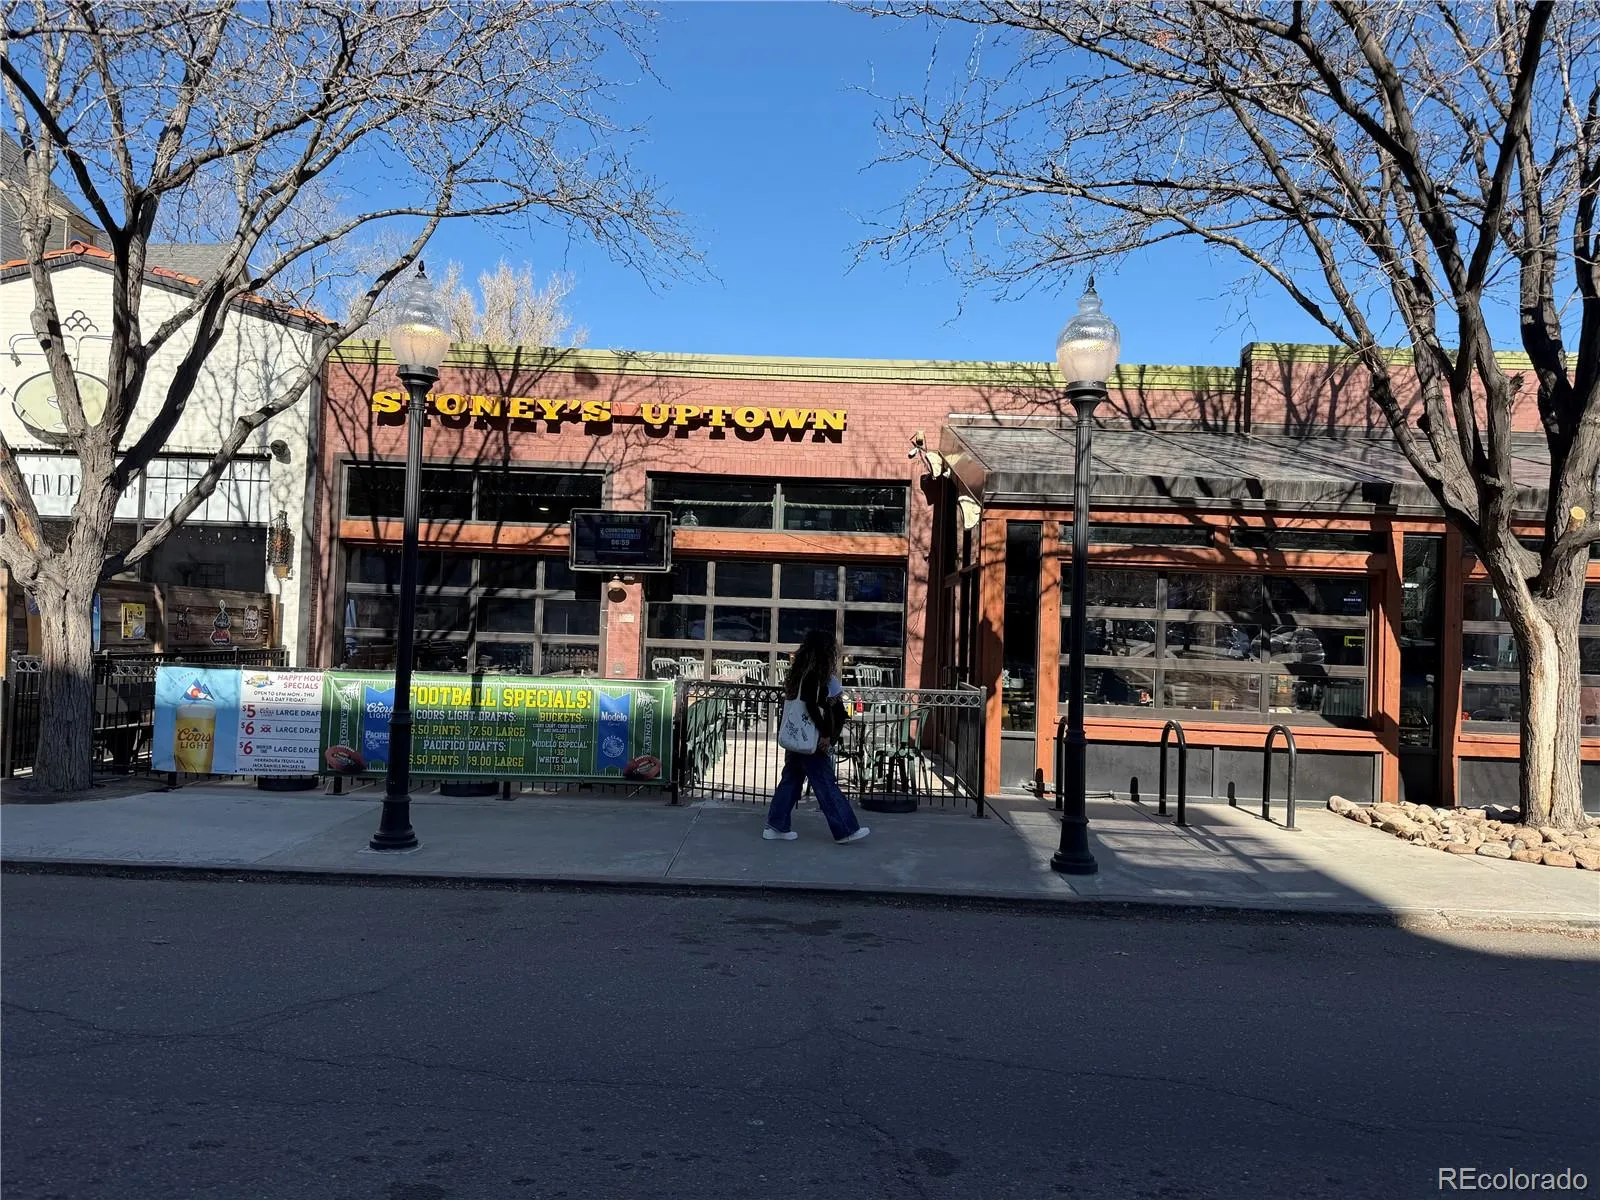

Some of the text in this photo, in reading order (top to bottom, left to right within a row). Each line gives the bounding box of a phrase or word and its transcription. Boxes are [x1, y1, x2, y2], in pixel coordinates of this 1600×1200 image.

[372, 391, 848, 430] SONEY'S UPTOWN
[283, 682, 319, 690] SPECIALS
[503, 688, 592, 709] SPECIALS!
[242, 704, 256, 718] $5
[367, 702, 394, 713] Coors
[416, 709, 517, 722] COORS LIGHT DRAFTS:
[540, 711, 585, 723] BUCKETS:
[241, 721, 254, 735] $6
[433, 725, 461, 735] PINTS
[496, 727, 526, 737] LARGE
[177, 728, 211, 742] Coors
[180, 742, 209, 750] LIGHT
[240, 741, 253, 755] $6
[423, 740, 507, 752] PACIFICO DRAFTS:
[558, 741, 587, 749] ESPECIAL
[431, 755, 459, 766] PINTS
[494, 757, 524, 767] LARGE
[539, 756, 560, 764] WHITE
